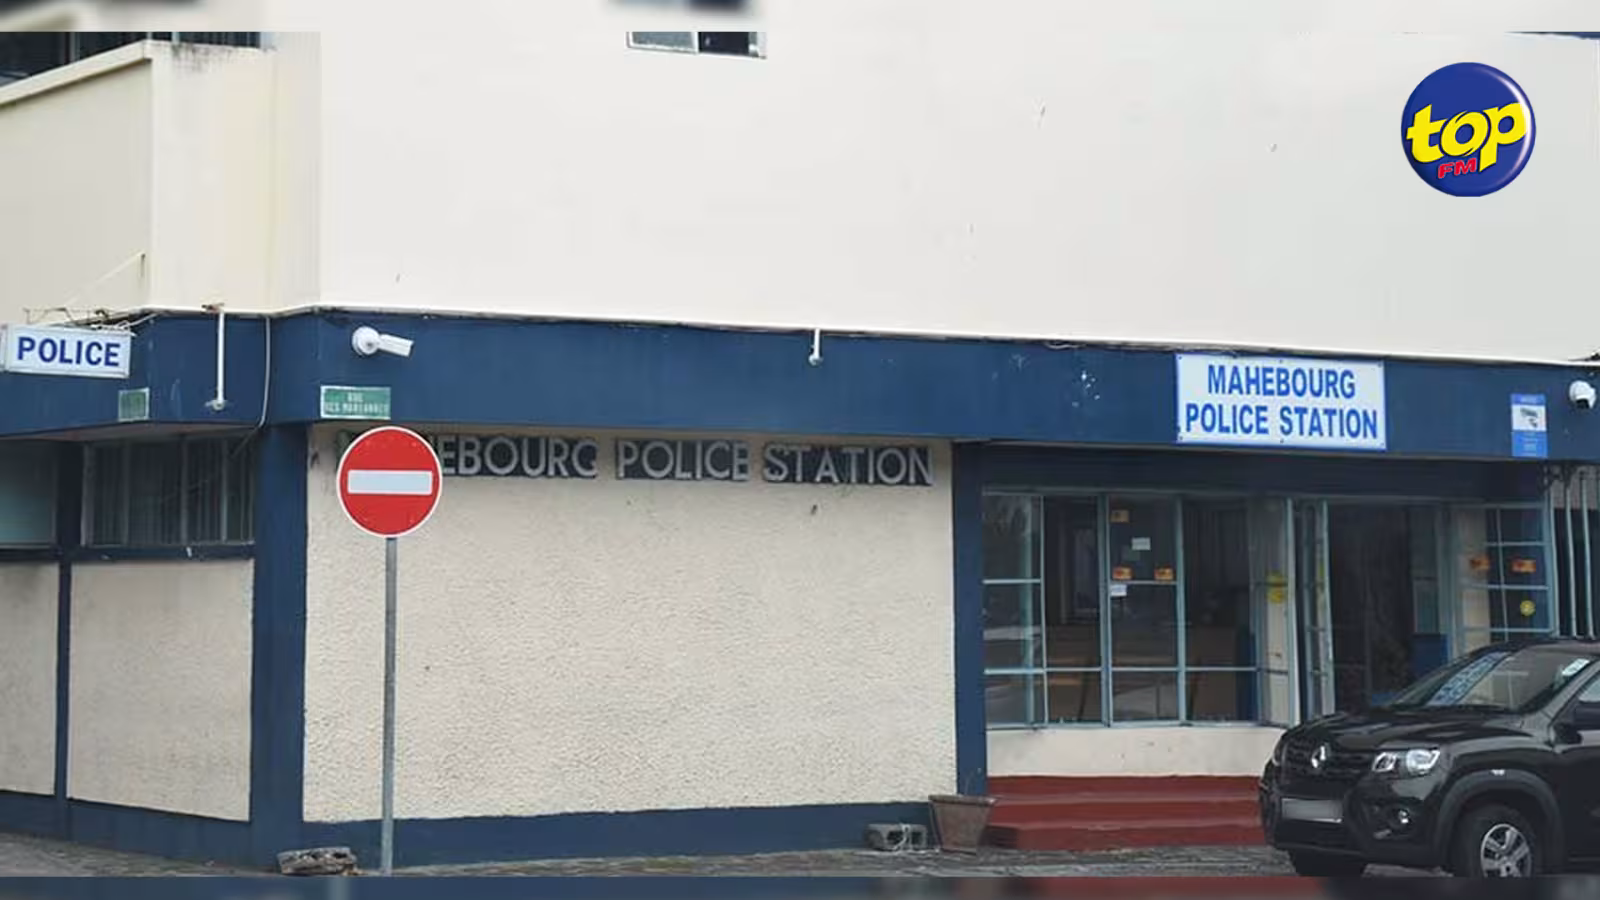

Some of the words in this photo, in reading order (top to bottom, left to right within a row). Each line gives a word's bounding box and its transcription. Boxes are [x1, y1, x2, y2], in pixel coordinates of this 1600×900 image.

[17, 336, 121, 367] POLICE
[1207, 364, 1356, 399] MAHEBOURG
[1185, 403, 1269, 435] POLICE
[1279, 405, 1378, 439] STATION
[336, 431, 600, 478] EBOURG
[617, 440, 752, 480] POLICE
[763, 443, 937, 485] STATION
